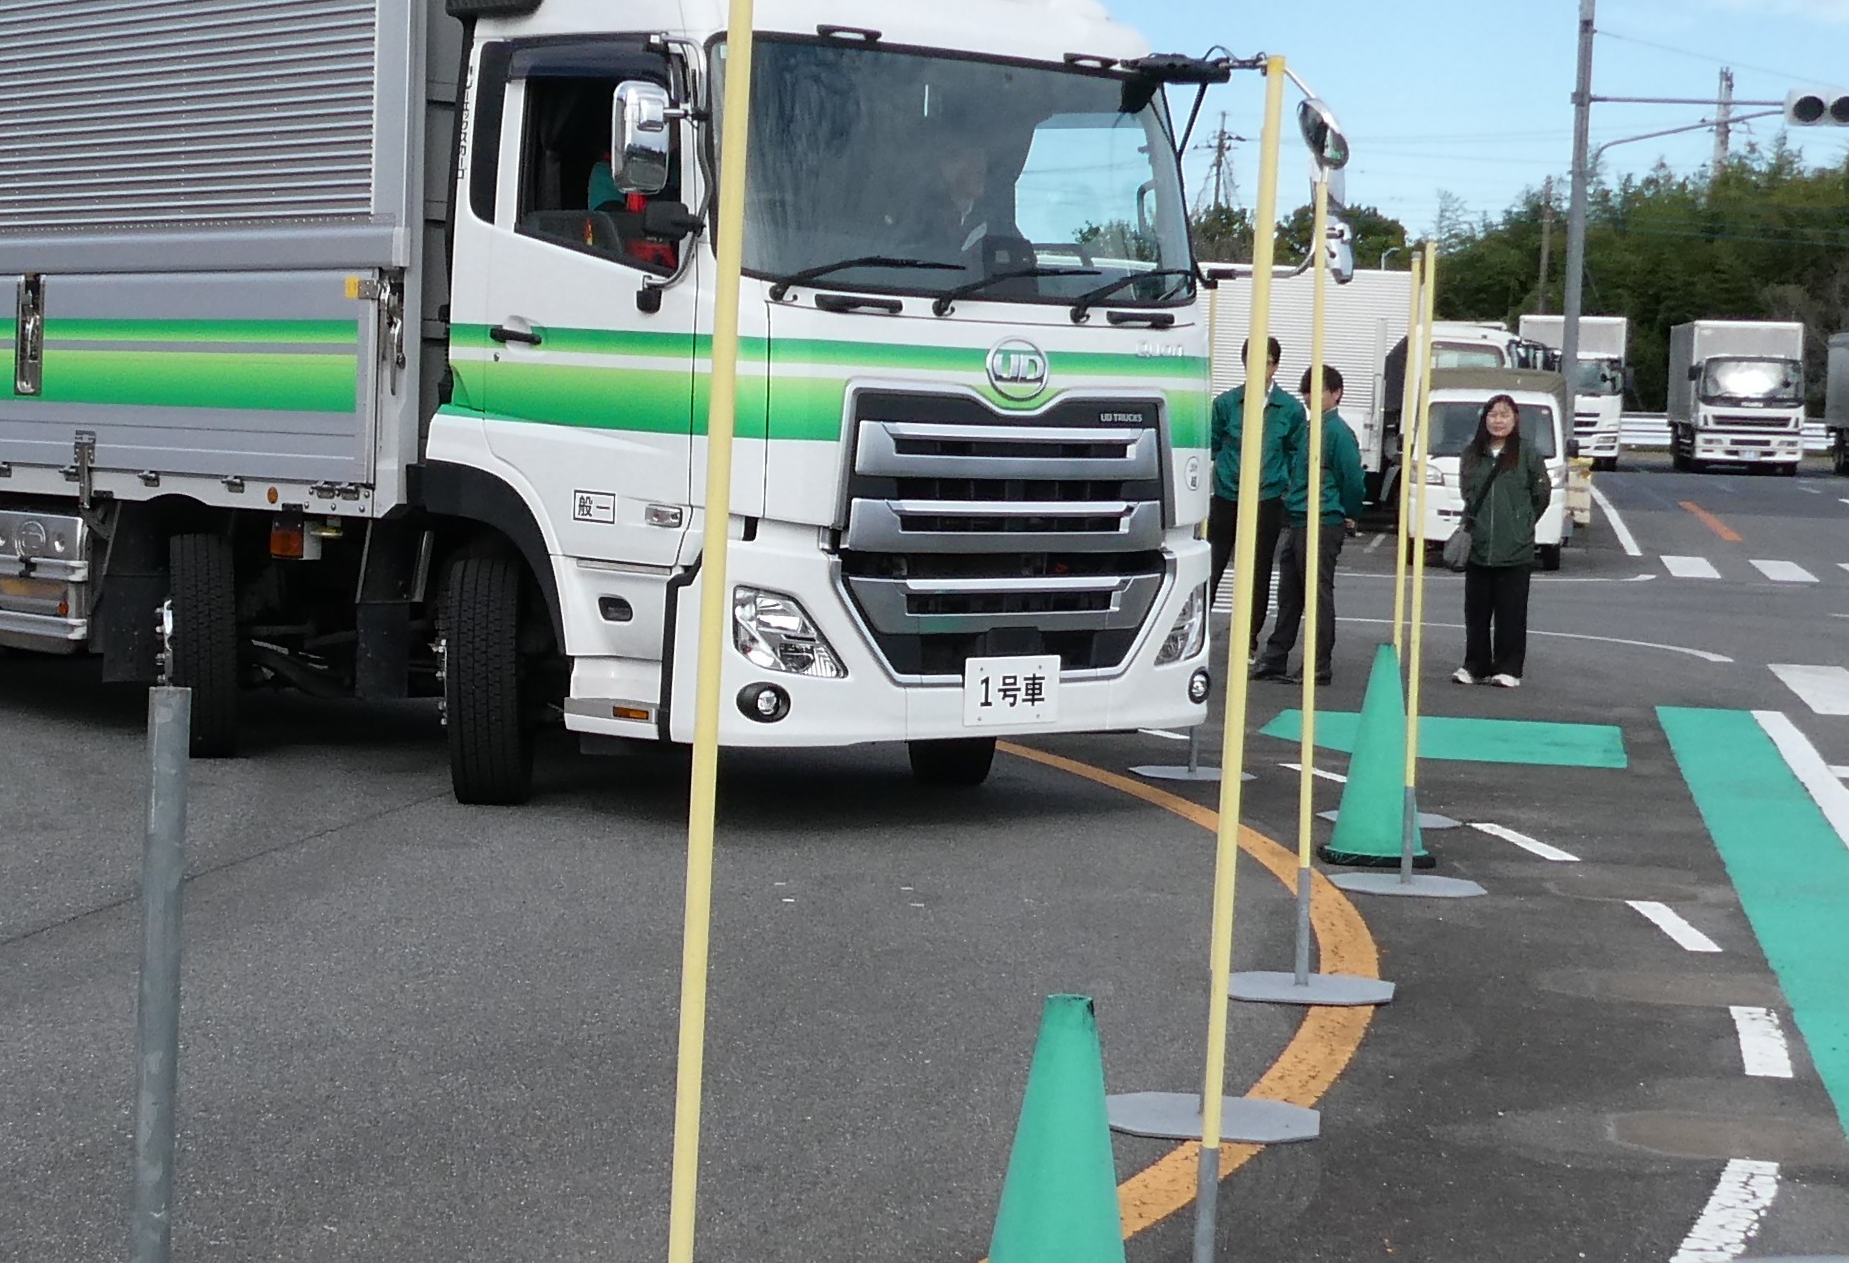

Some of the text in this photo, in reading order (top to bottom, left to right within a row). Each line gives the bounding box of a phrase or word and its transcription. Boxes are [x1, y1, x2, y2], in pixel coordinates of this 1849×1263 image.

[992, 353, 1045, 382] UD
[1100, 413, 1143, 423] UD TRUCKS
[577, 495, 611, 517] 般一
[979, 673, 1046, 708] 1号車
